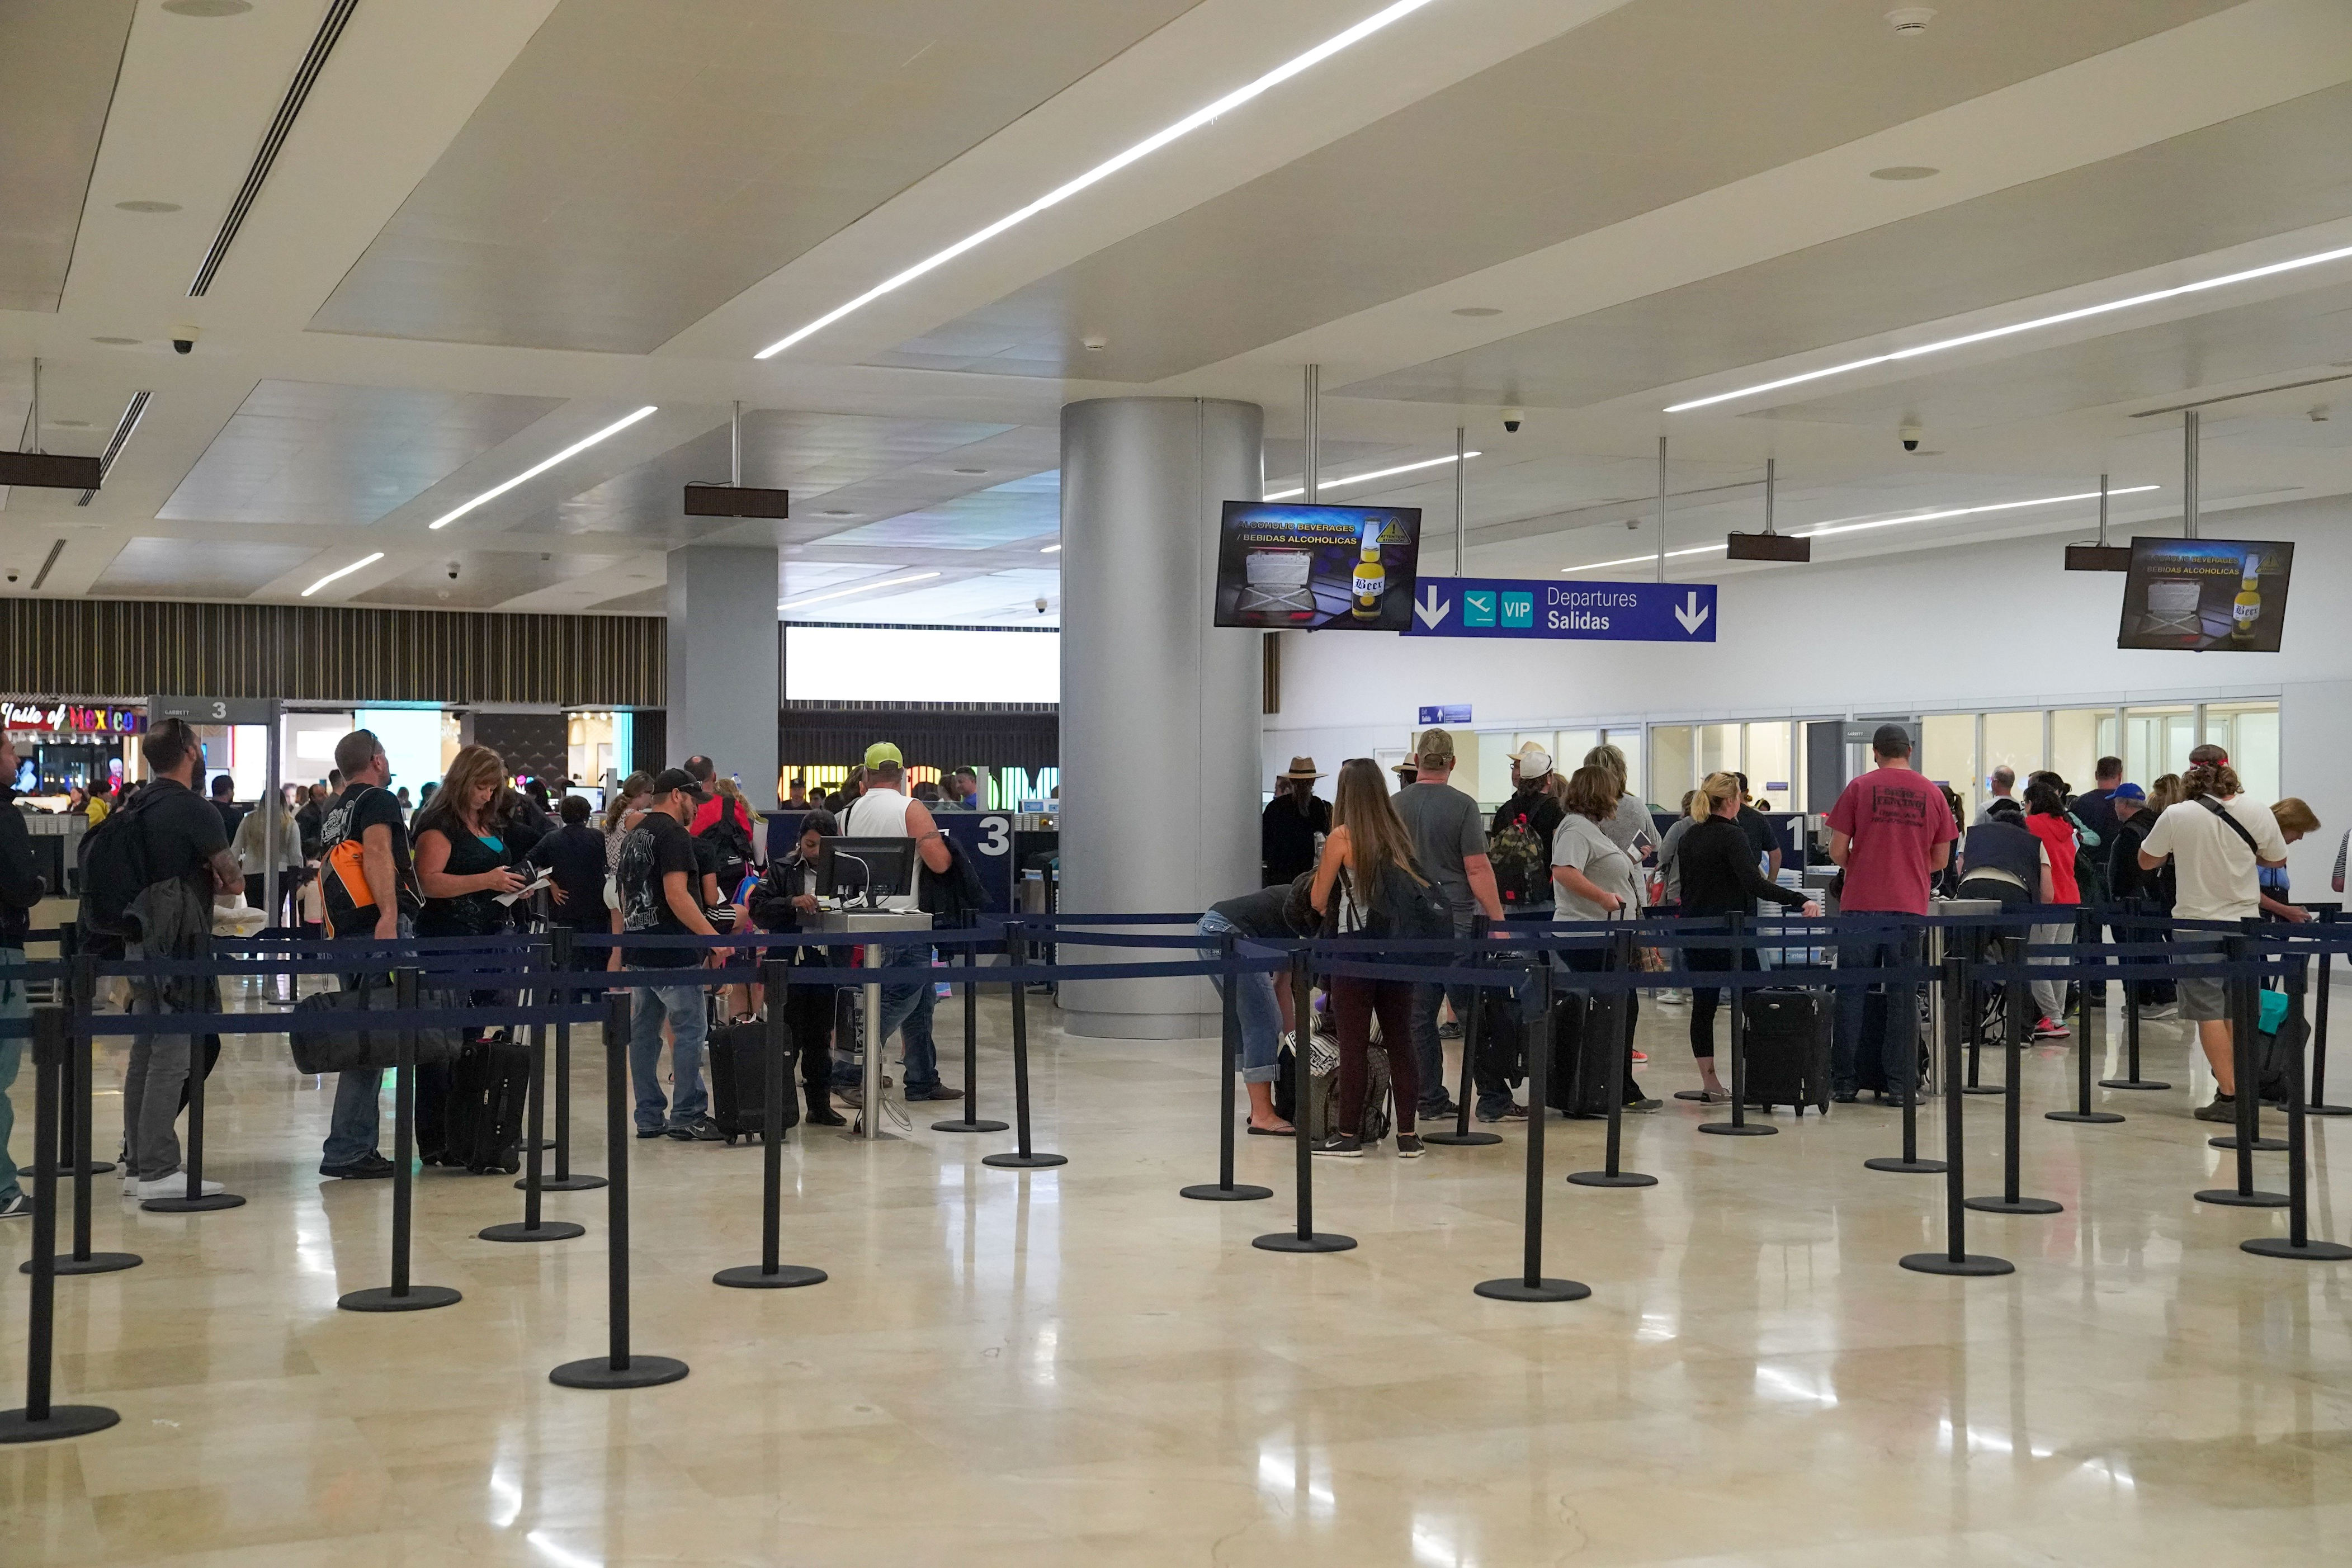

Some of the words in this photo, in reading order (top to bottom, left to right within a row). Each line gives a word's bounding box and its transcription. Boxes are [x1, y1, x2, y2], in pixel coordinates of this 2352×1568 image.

[1238, 521, 1295, 530] ALCOHOLIC
[1297, 523, 1355, 532] BEVERAGES
[1288, 535, 1357, 545] ALCOHOLICAS
[2183, 567, 2240, 575] ALCOHOLICAS
[1355, 578, 1383, 591] Beer
[1548, 587, 1637, 610] Departures
[1504, 602, 1531, 618] VIP
[2236, 605, 2259, 616] Beer
[1548, 610, 1610, 630] Salidas
[1, 702, 43, 728] Taste
[47, 703, 66, 730] of
[212, 702, 226, 719] 3
[977, 816, 1010, 856] 3
[1786, 816, 1803, 851] 1
